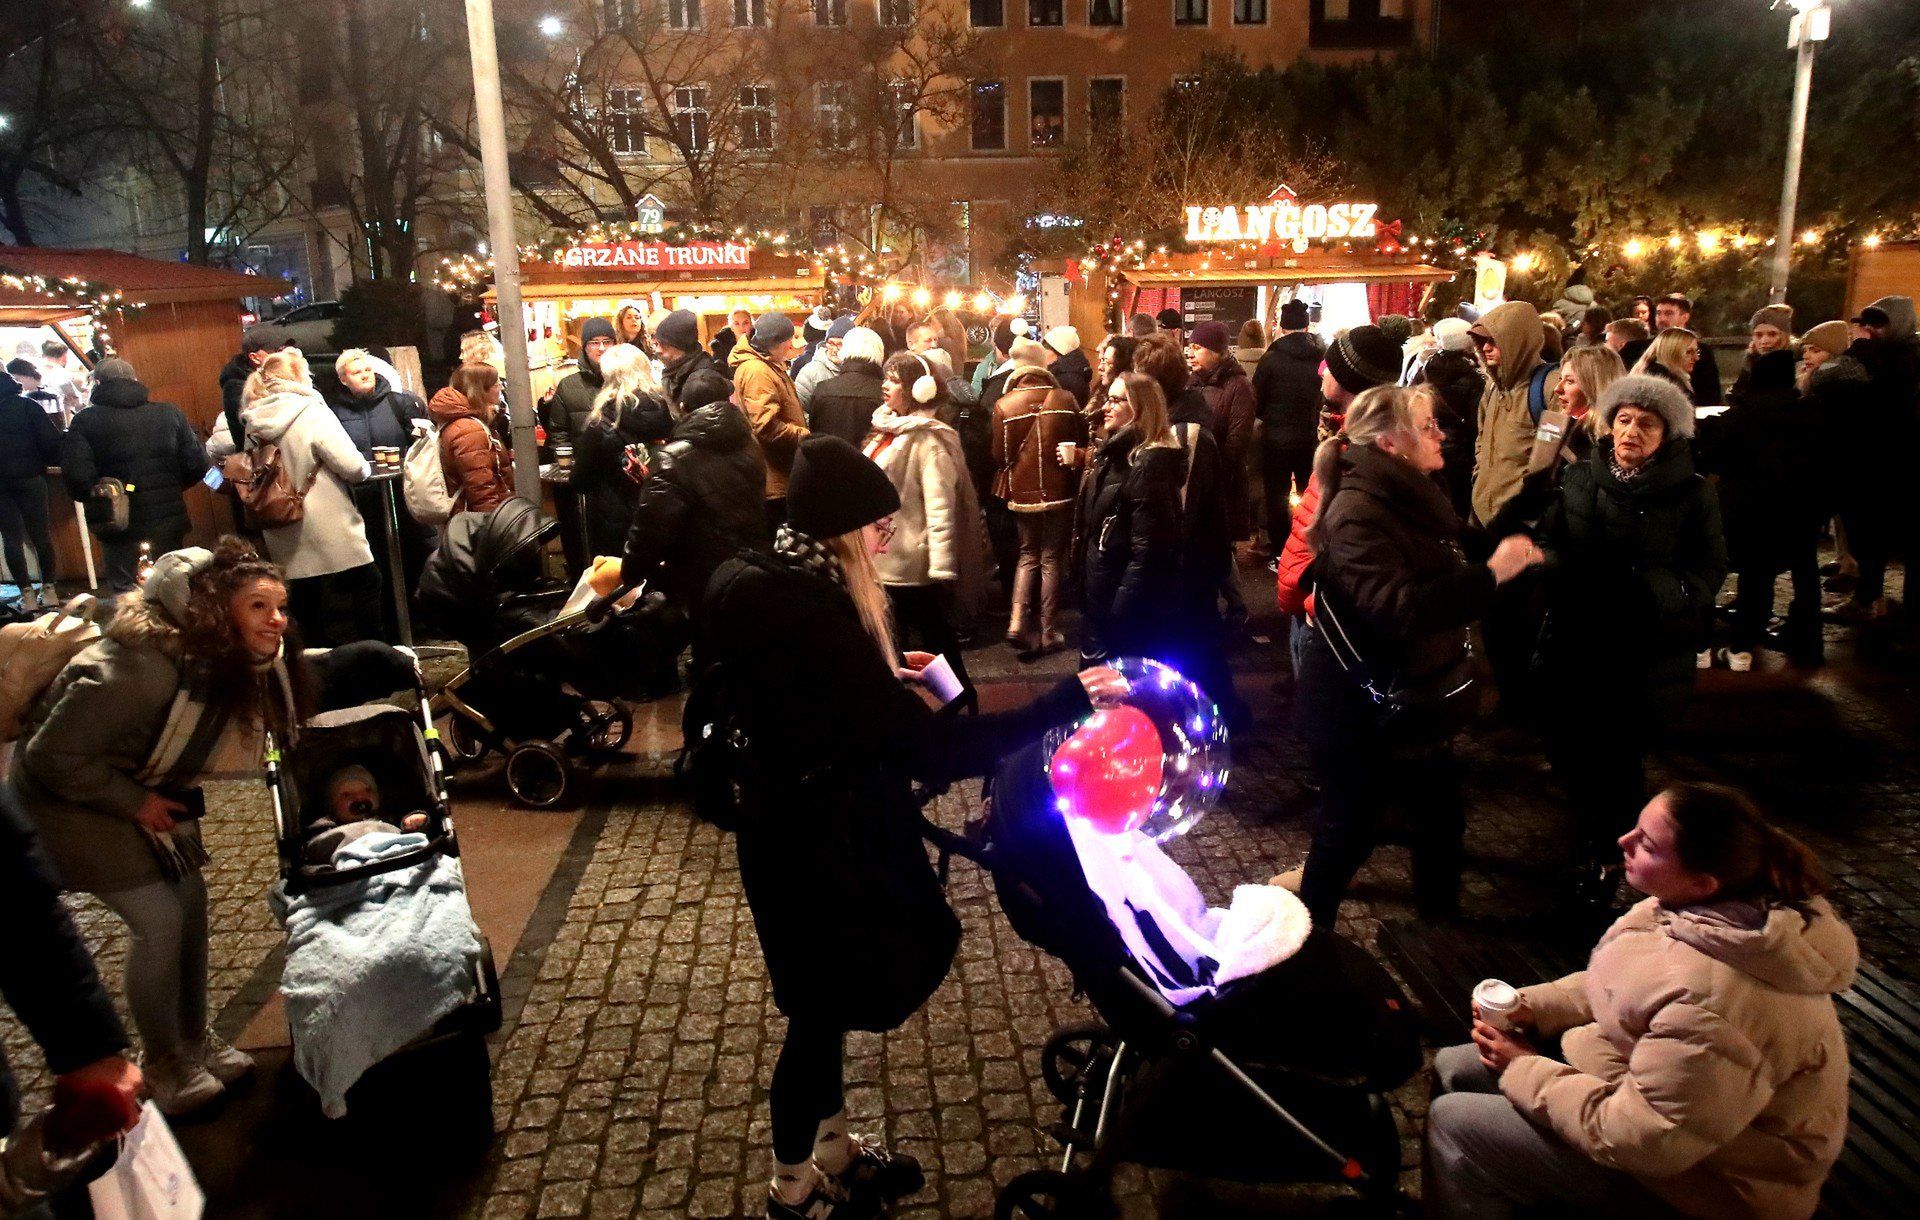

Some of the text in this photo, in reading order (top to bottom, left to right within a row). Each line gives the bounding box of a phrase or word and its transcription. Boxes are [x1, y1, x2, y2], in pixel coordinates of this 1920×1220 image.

[640, 208, 661, 223] 79
[1185, 203, 1378, 241] LANGOSZ
[566, 246, 746, 267] GRZANE TRUNKI
[1194, 288, 1244, 299] LANGOSZ
